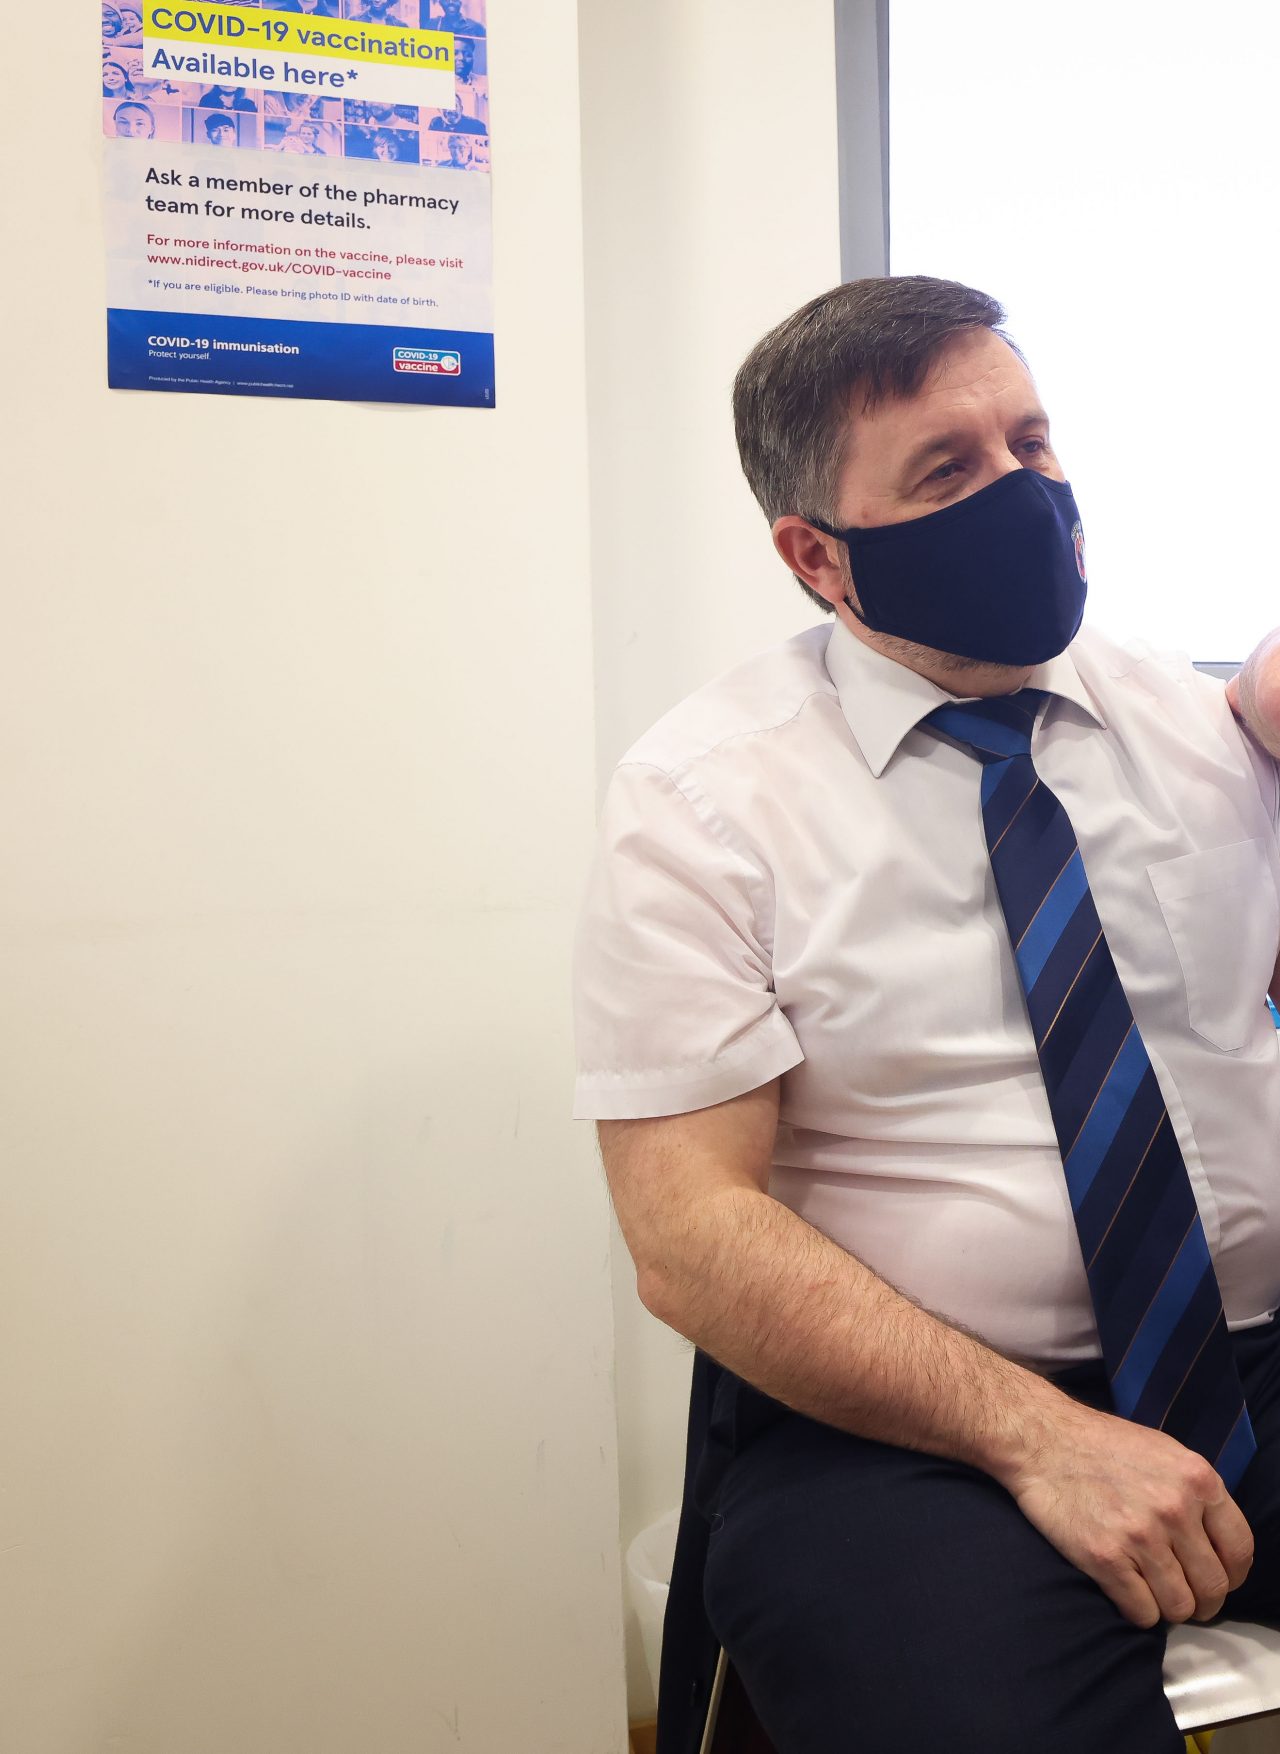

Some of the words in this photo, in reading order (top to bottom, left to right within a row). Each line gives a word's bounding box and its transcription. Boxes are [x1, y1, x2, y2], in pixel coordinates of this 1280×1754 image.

[152, 8, 288, 41] COVID-19
[297, 29, 448, 61] vaccination
[152, 49, 274, 80] Available
[145, 168, 182, 186] Ask
[189, 176, 199, 187] a
[207, 177, 293, 195] member
[299, 183, 319, 198] of
[325, 185, 357, 201] the
[364, 189, 459, 215] pharmacy
[145, 196, 198, 215] team
[205, 201, 235, 217] for
[242, 208, 294, 222] more
[301, 209, 370, 229] details.
[147, 233, 171, 246] For
[173, 238, 210, 249] more
[213, 238, 291, 256] information
[294, 248, 312, 257] on
[314, 247, 337, 259] the
[339, 250, 393, 265] vaccine,
[395, 253, 436, 267] please
[439, 257, 464, 269] visit
[146, 254, 392, 280] www.nidirect.gov.uk/COVID-vaccine
[162, 281, 182, 291] you
[184, 283, 202, 291] are
[203, 283, 244, 295] eligible.
[245, 285, 279, 297] Please
[280, 288, 307, 301] bring
[308, 290, 339, 301] photo
[340, 292, 351, 301] ID
[353, 294, 374, 302] with
[376, 295, 398, 304] date
[400, 296, 410, 305] of
[412, 296, 440, 309] birth.
[148, 336, 209, 348] COVID-19
[213, 339, 299, 354] immunisation
[148, 349, 177, 359] Protect
[178, 351, 213, 361] yourself.
[397, 352, 437, 362] COVID-19
[399, 363, 438, 373] vaccine
